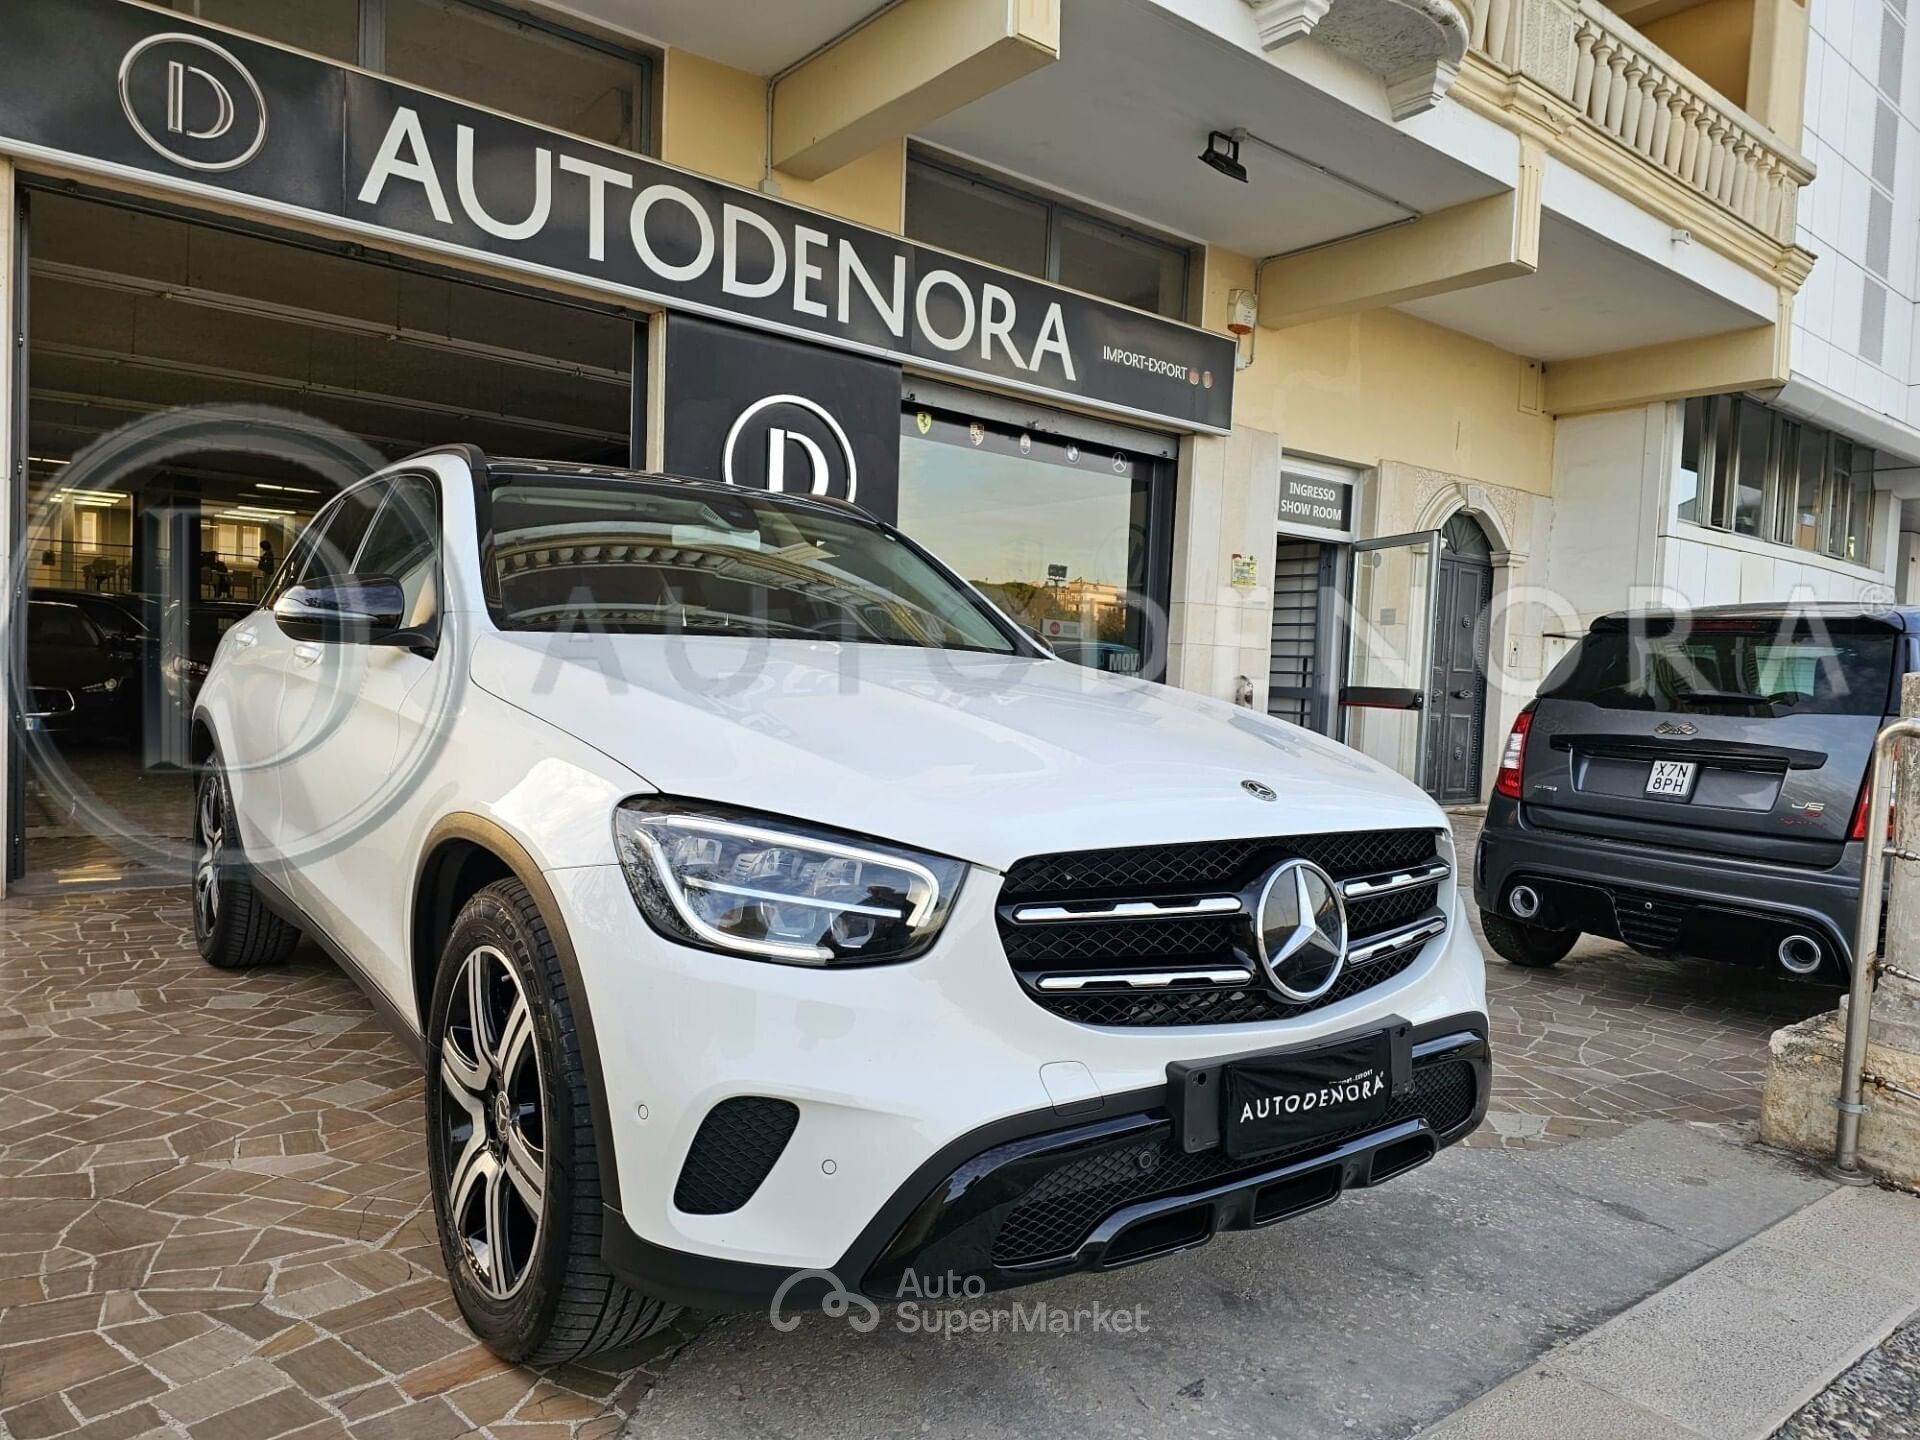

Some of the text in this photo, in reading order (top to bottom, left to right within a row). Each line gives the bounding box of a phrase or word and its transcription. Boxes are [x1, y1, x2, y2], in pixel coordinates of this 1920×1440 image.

[357, 106, 1077, 382] AUTODENORA
[1103, 345, 1188, 380] IMPORT-EXPORT
[1289, 482, 1336, 501] INGRESSO
[1281, 499, 1342, 521] SHOW ROOM
[1656, 762, 1689, 778] X7N
[1652, 777, 1685, 793] 8PH
[1239, 1072, 1385, 1124] AUTODENORA
